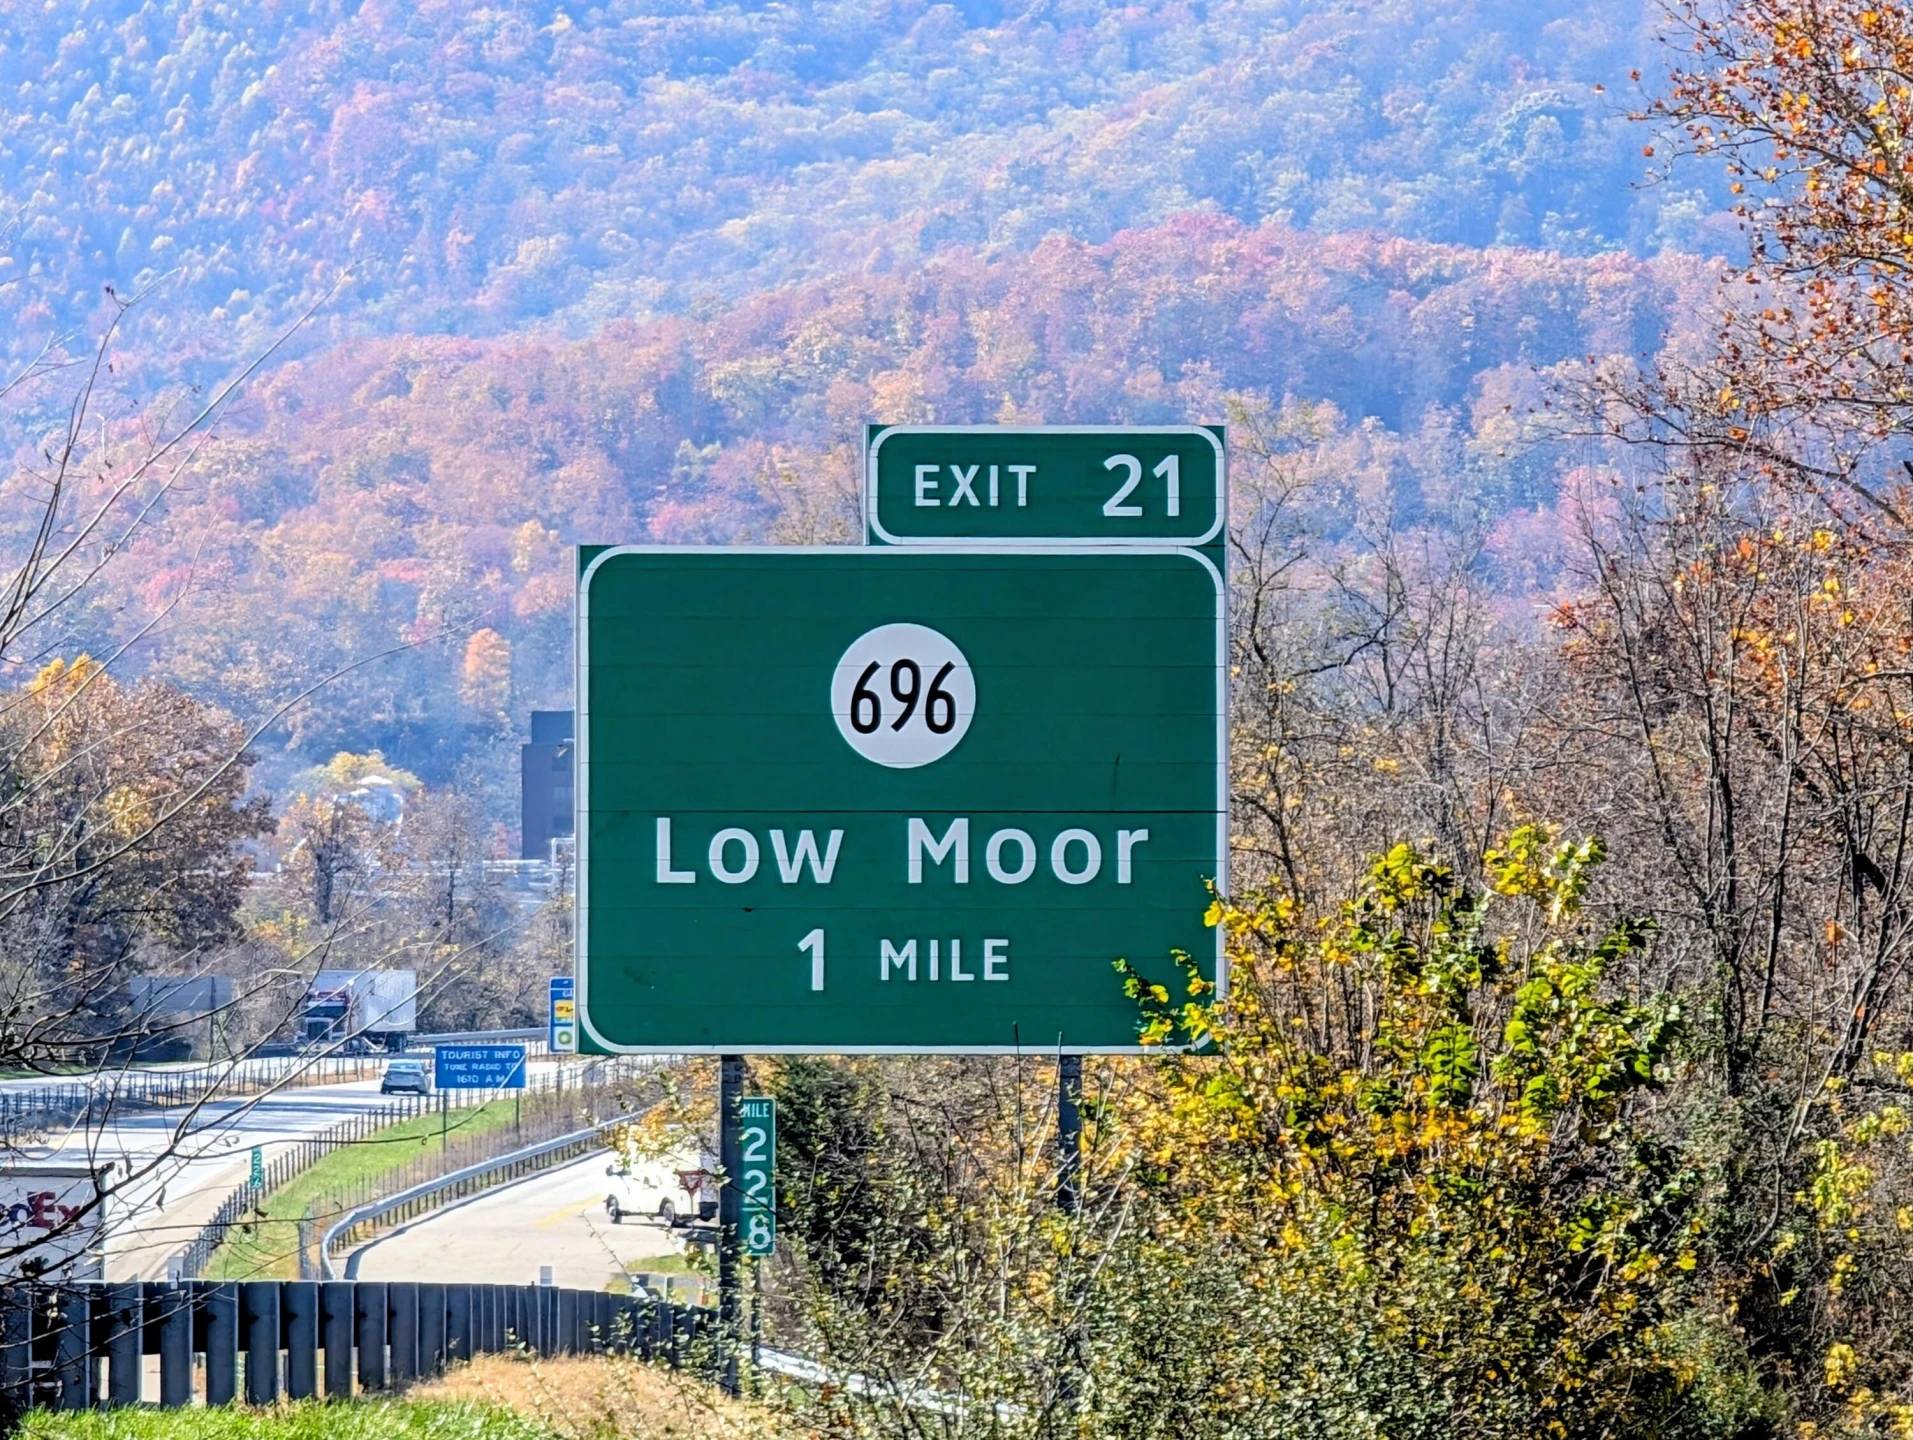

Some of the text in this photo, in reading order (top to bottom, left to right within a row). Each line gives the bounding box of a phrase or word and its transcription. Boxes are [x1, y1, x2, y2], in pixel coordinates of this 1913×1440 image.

[915, 454, 1180, 517] EXIT 21
[850, 658, 957, 735] 696
[656, 817, 1149, 885] Low Moor
[797, 928, 1011, 991] 1 MILE
[441, 1050, 521, 1060] TOURIST INFO
[471, 1063, 502, 1071] RADIO
[456, 1074, 479, 1083] 1610
[741, 1102, 770, 1118] MILE
